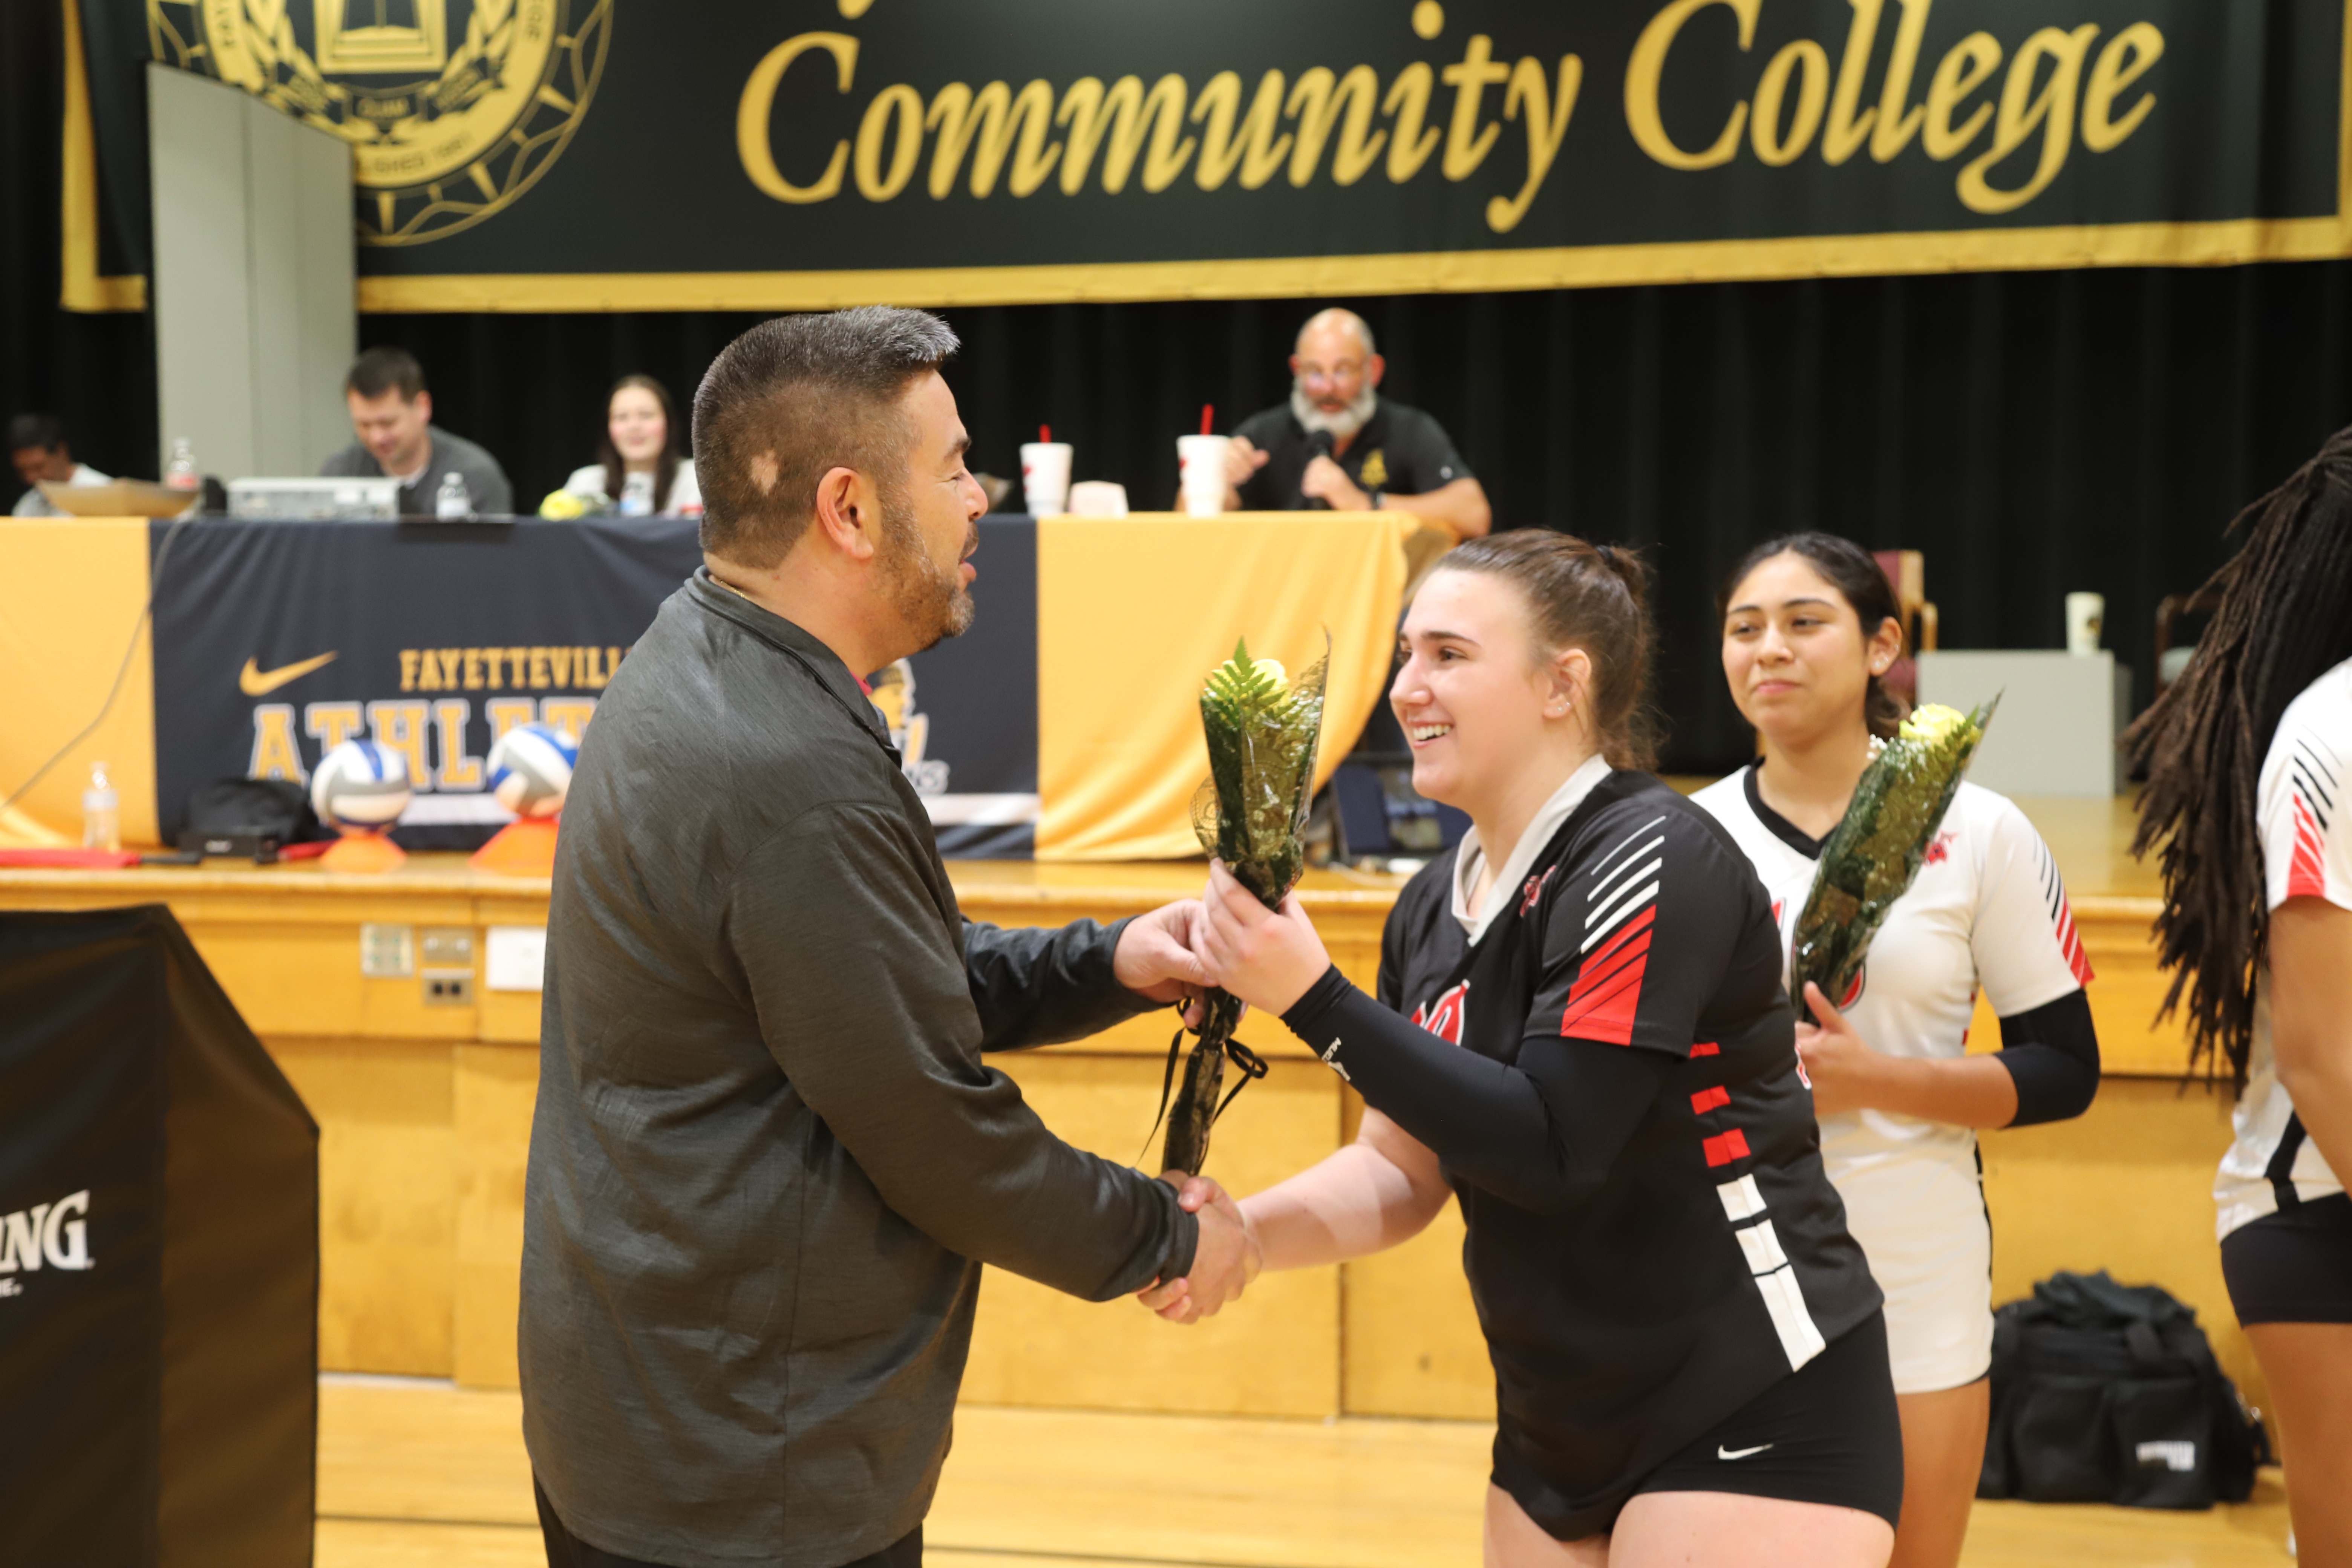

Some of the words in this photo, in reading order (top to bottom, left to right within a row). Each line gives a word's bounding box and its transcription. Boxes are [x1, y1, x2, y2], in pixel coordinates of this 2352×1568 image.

[736, 0, 1583, 233] Community
[1623, 0, 2165, 214] College
[399, 645, 635, 691] FAYETTEVILL
